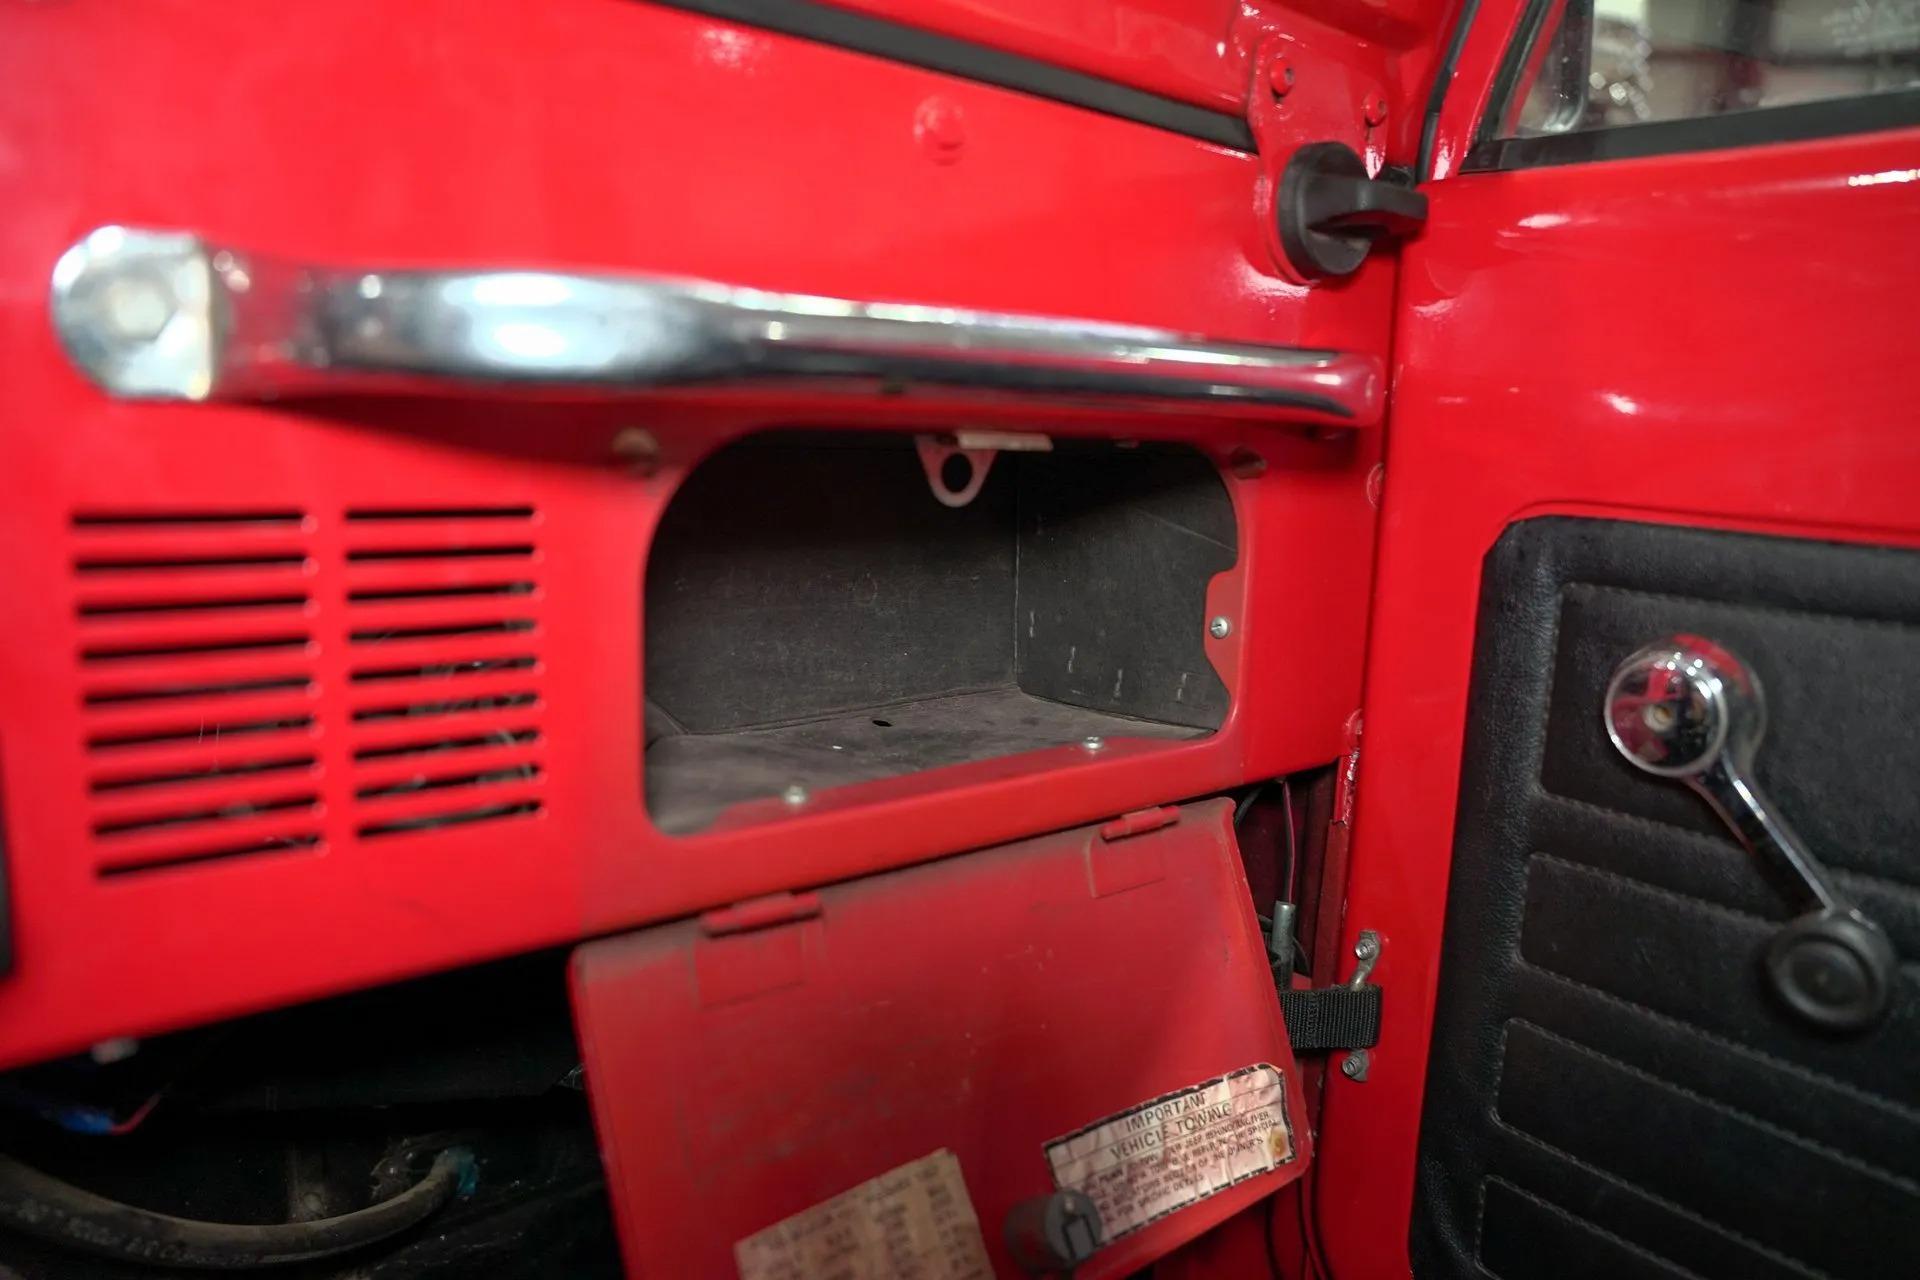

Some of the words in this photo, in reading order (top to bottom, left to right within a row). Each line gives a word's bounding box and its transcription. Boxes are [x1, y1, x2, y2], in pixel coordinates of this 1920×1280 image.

[1109, 1123, 1171, 1162] VEHICLE
[1174, 1101, 1233, 1134] TOWING
[1124, 1091, 1208, 1133] IMPORTANT
